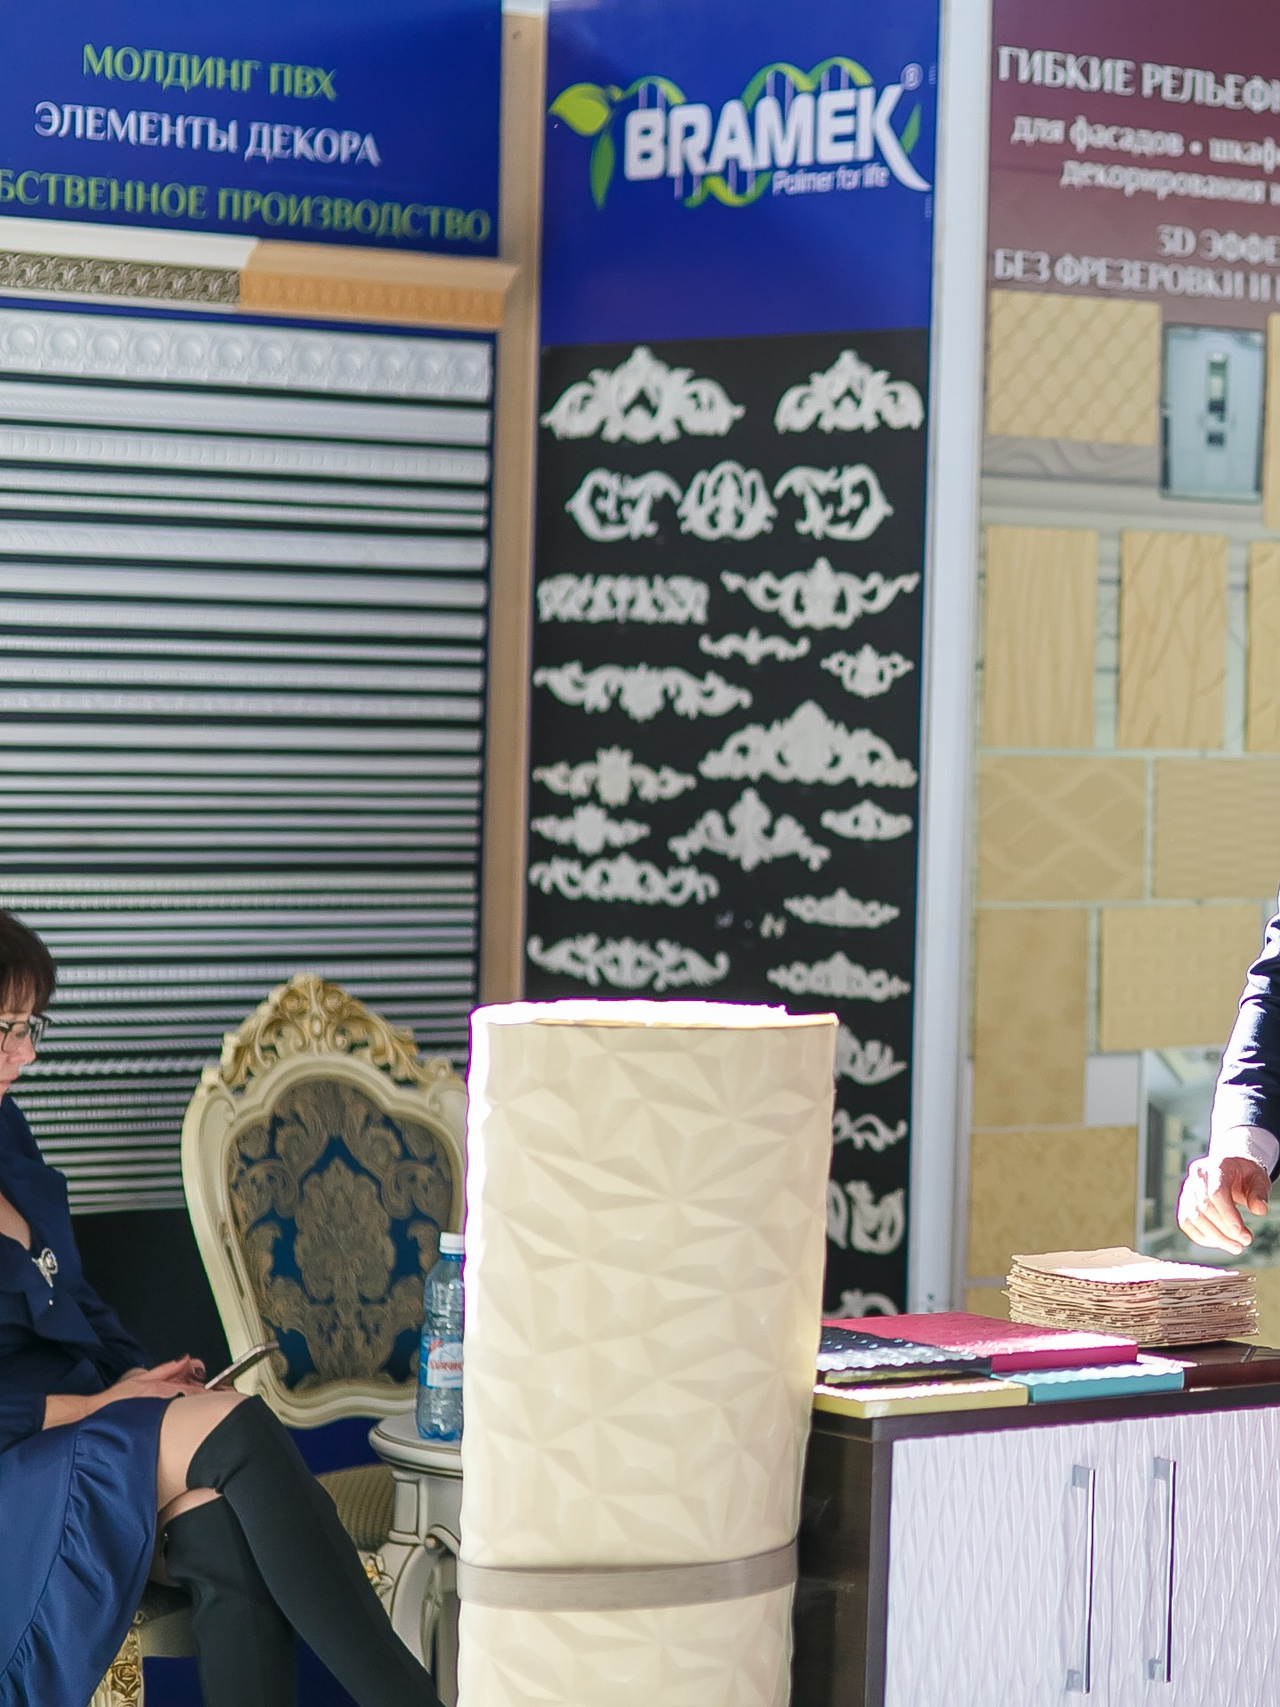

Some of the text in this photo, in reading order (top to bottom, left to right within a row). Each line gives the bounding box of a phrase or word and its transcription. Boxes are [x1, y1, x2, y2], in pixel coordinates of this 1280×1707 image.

[83, 43, 338, 101] МОЛДИНГ ПВХ
[997, 46, 1136, 96] ГИБКИЕ
[34, 101, 382, 168] ЭЛЕМЕНТЫ ДЕКОРА
[624, 83, 933, 192] BRAMEK
[217, 188, 491, 242] ПРОИЗВОДСТВО
[993, 248, 1050, 282] БЕЗ
